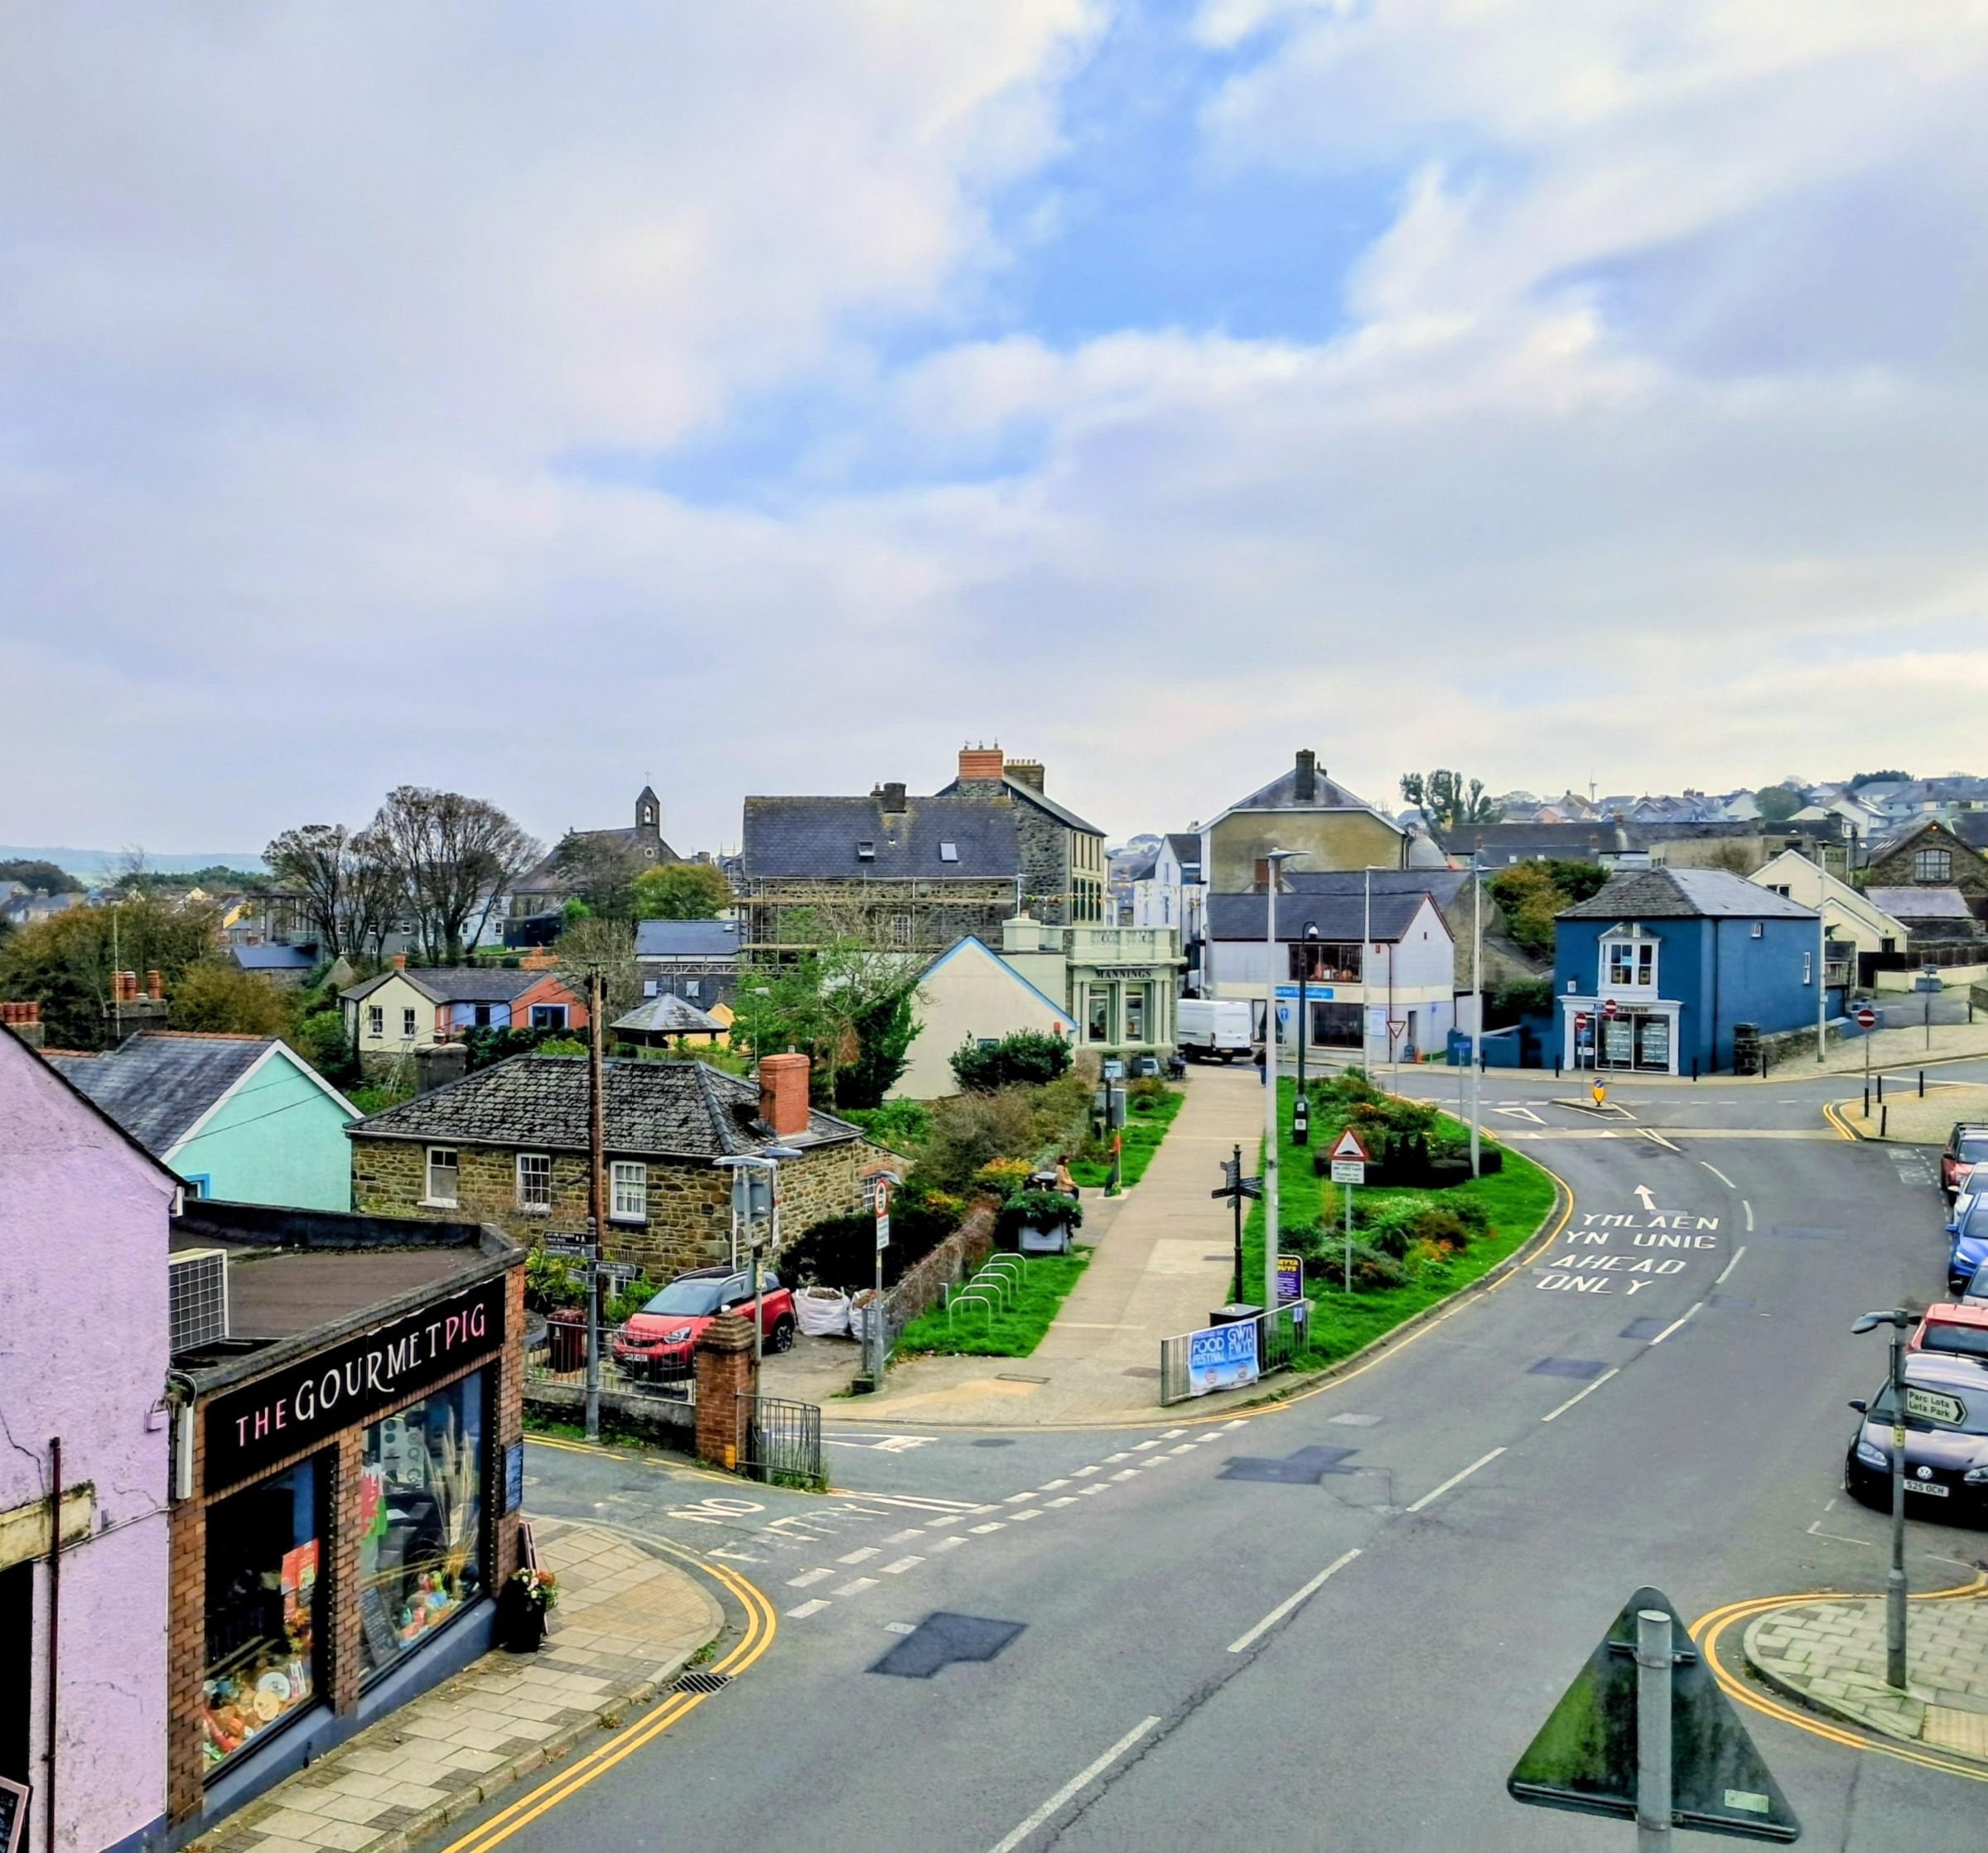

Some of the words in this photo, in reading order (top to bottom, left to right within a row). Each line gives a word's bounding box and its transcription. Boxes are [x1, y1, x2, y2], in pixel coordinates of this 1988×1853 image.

[1095, 968, 1151, 978] MANNINGS
[1584, 1214, 1719, 1230] YMLAEN
[1566, 1231, 1609, 1245] YN
[1633, 1233, 1717, 1248] UNIG
[1550, 1254, 1686, 1274] AHEAD
[1536, 1274, 1654, 1296] ONLY
[1193, 1336, 1224, 1355] FOOD
[235, 1398, 287, 1447] THE
[294, 1322, 442, 1421] GOURMET
[446, 1302, 485, 1351] PIG
[1908, 1392, 1928, 1403] Parc
[1931, 1397, 1950, 1408] Lota
[1908, 1401, 1928, 1412] Lota
[1931, 1407, 1951, 1417] Park
[667, 1498, 766, 1525] NO
